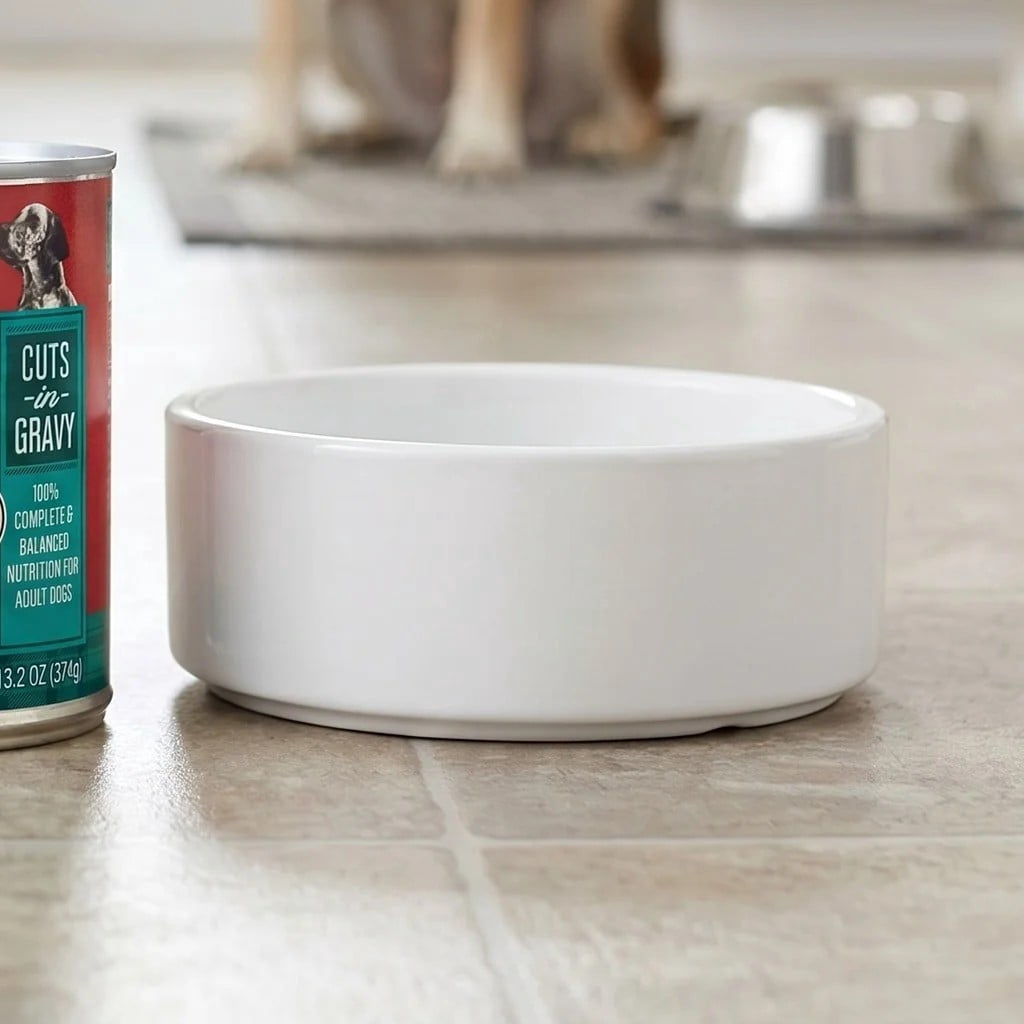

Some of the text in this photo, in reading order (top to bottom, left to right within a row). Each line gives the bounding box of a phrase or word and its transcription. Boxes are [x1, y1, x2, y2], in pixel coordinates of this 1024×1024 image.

[22, 341, 69, 382] CUTS
[14, 412, 76, 455] GRAVY
[32, 483, 59, 503] 100%
[14, 505, 74, 530] COMPLETE &
[19, 532, 69, 556] BALANCED
[7, 556, 79, 583] NUTRITION FOR
[15, 583, 73, 609] ADULT DOGS
[29, 663, 47, 687] OZ
[49, 657, 83, 688] (374g)
